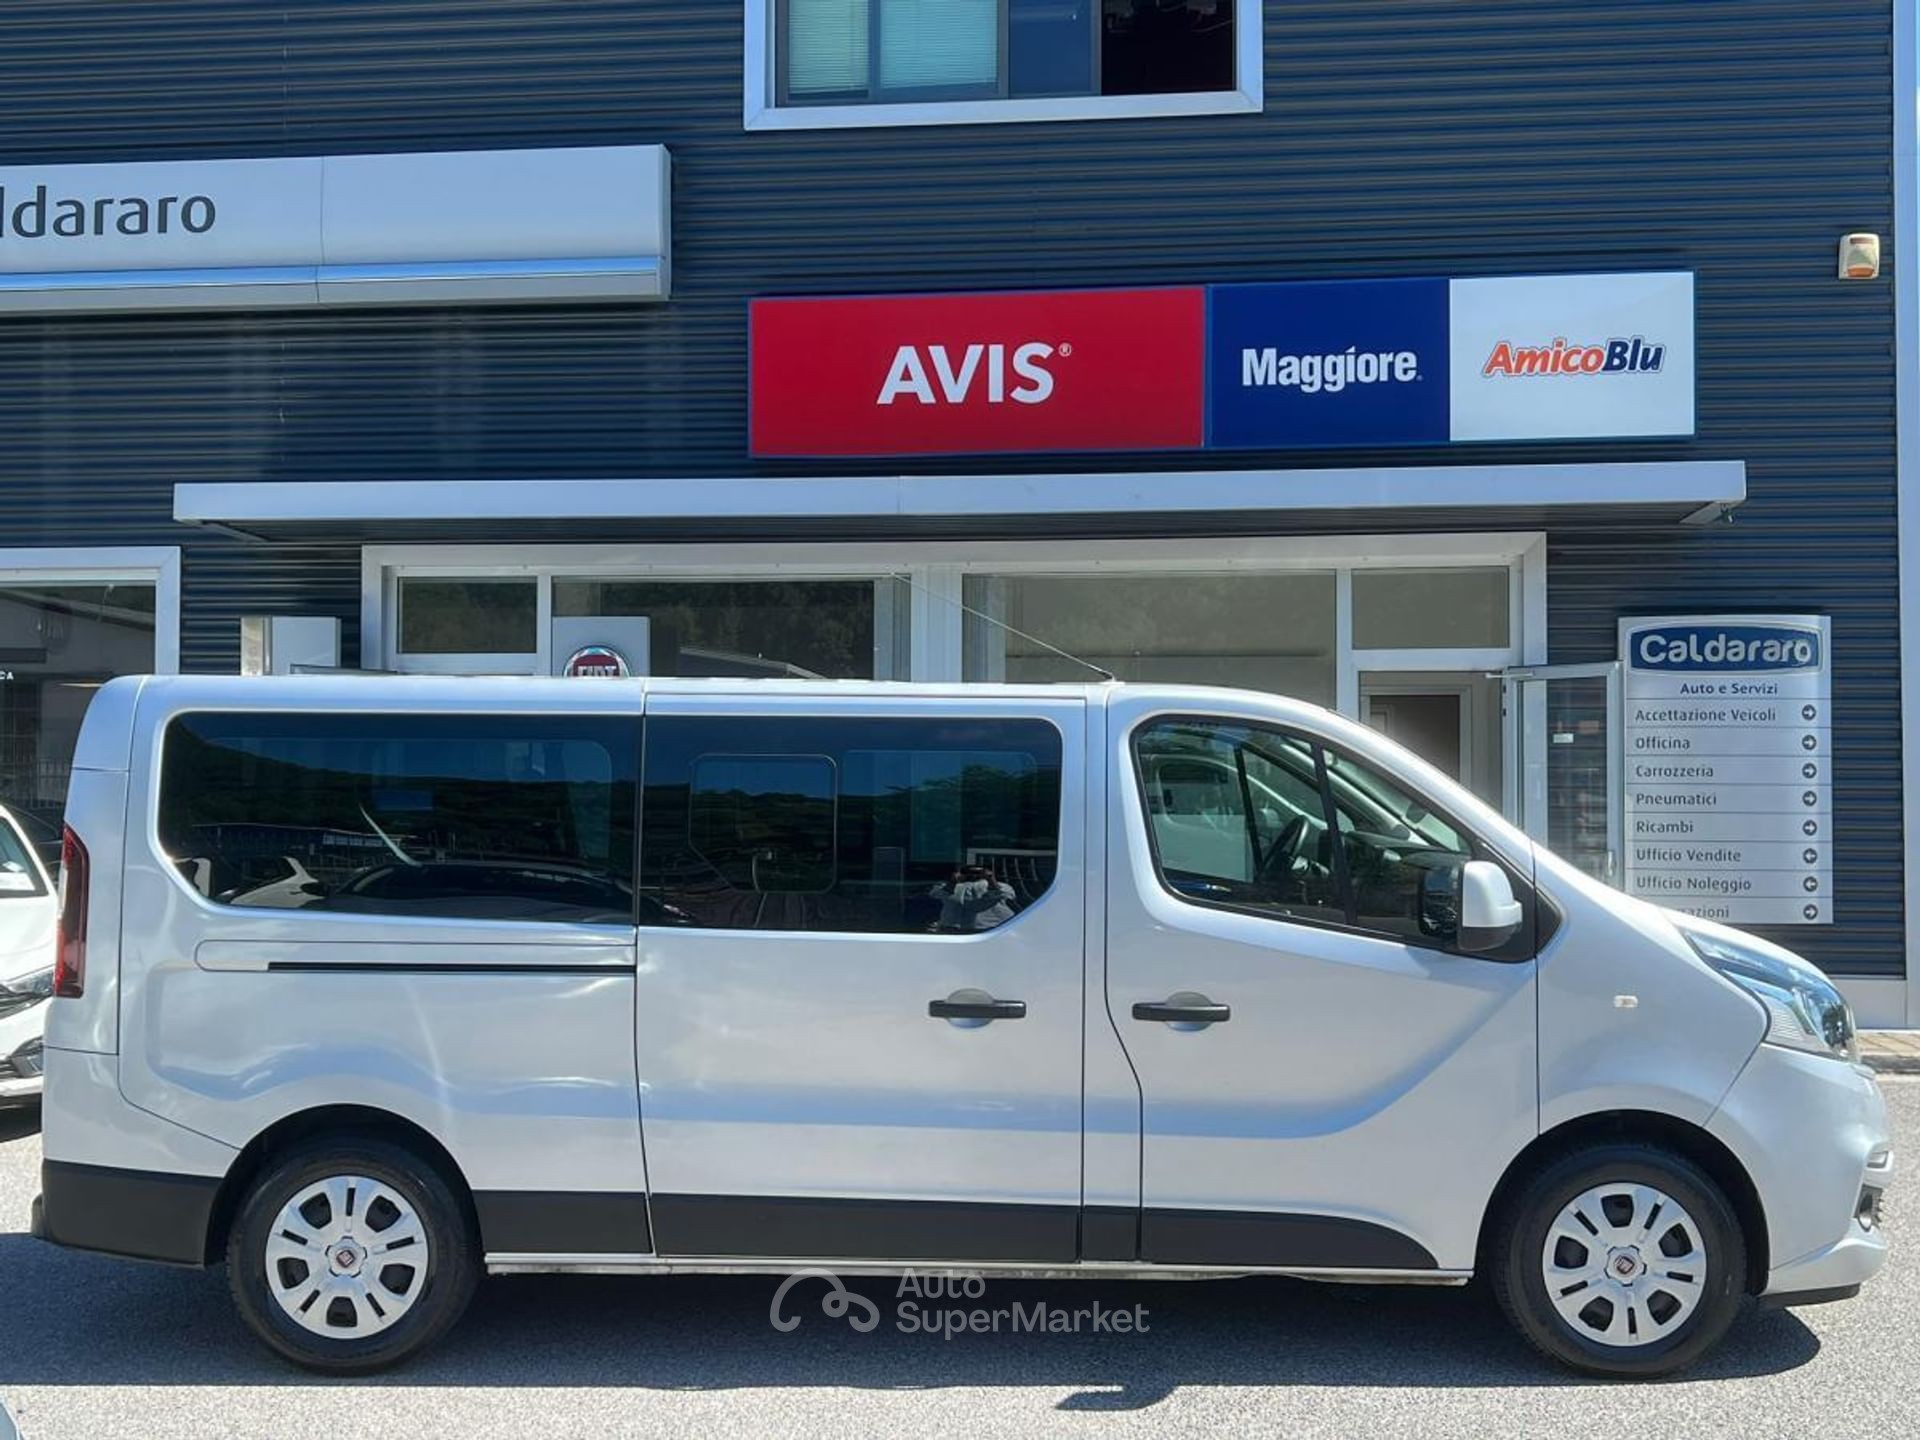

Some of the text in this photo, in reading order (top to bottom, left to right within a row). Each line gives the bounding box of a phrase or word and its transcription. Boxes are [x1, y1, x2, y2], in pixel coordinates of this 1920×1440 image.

[1483, 337, 1664, 376] AmicoBlu
[1242, 346, 1417, 393] Maggiore
[1640, 633, 1812, 664] Caldararo
[1680, 683, 1778, 694] Auto e Servizi
[1635, 708, 1776, 721] Accettazione Veicoli
[1636, 736, 1690, 749] Officina
[1636, 764, 1714, 777] Carrozzeria
[1636, 793, 1717, 805] Pneumatici
[1636, 820, 1694, 833] Ricambi
[1636, 848, 1741, 862] Ufficio Vendite
[1636, 876, 1752, 893] Ufficio Noleggio
